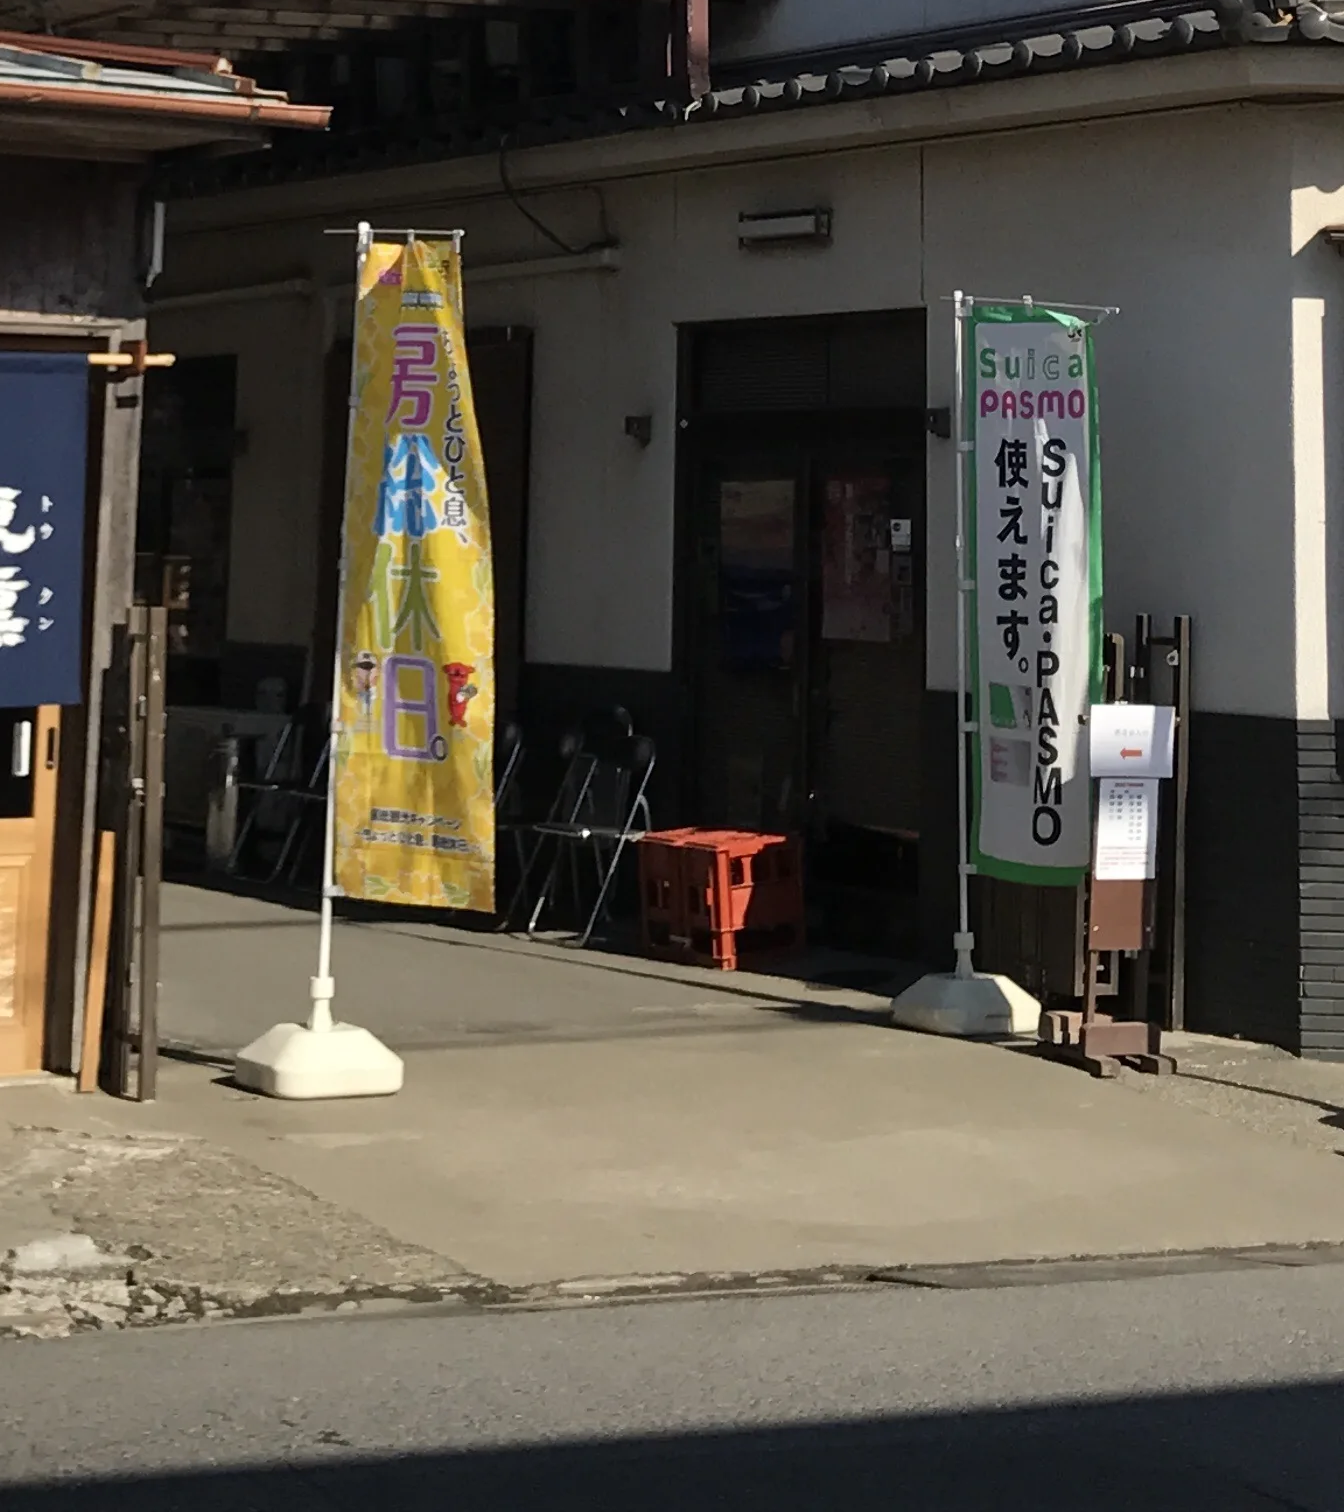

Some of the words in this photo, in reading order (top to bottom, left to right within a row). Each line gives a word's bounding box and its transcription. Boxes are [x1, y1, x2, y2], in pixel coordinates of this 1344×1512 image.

[979, 348, 1084, 381] Suica
[980, 389, 1086, 420] PASMO
[994, 438, 1029, 674] 使えます。
